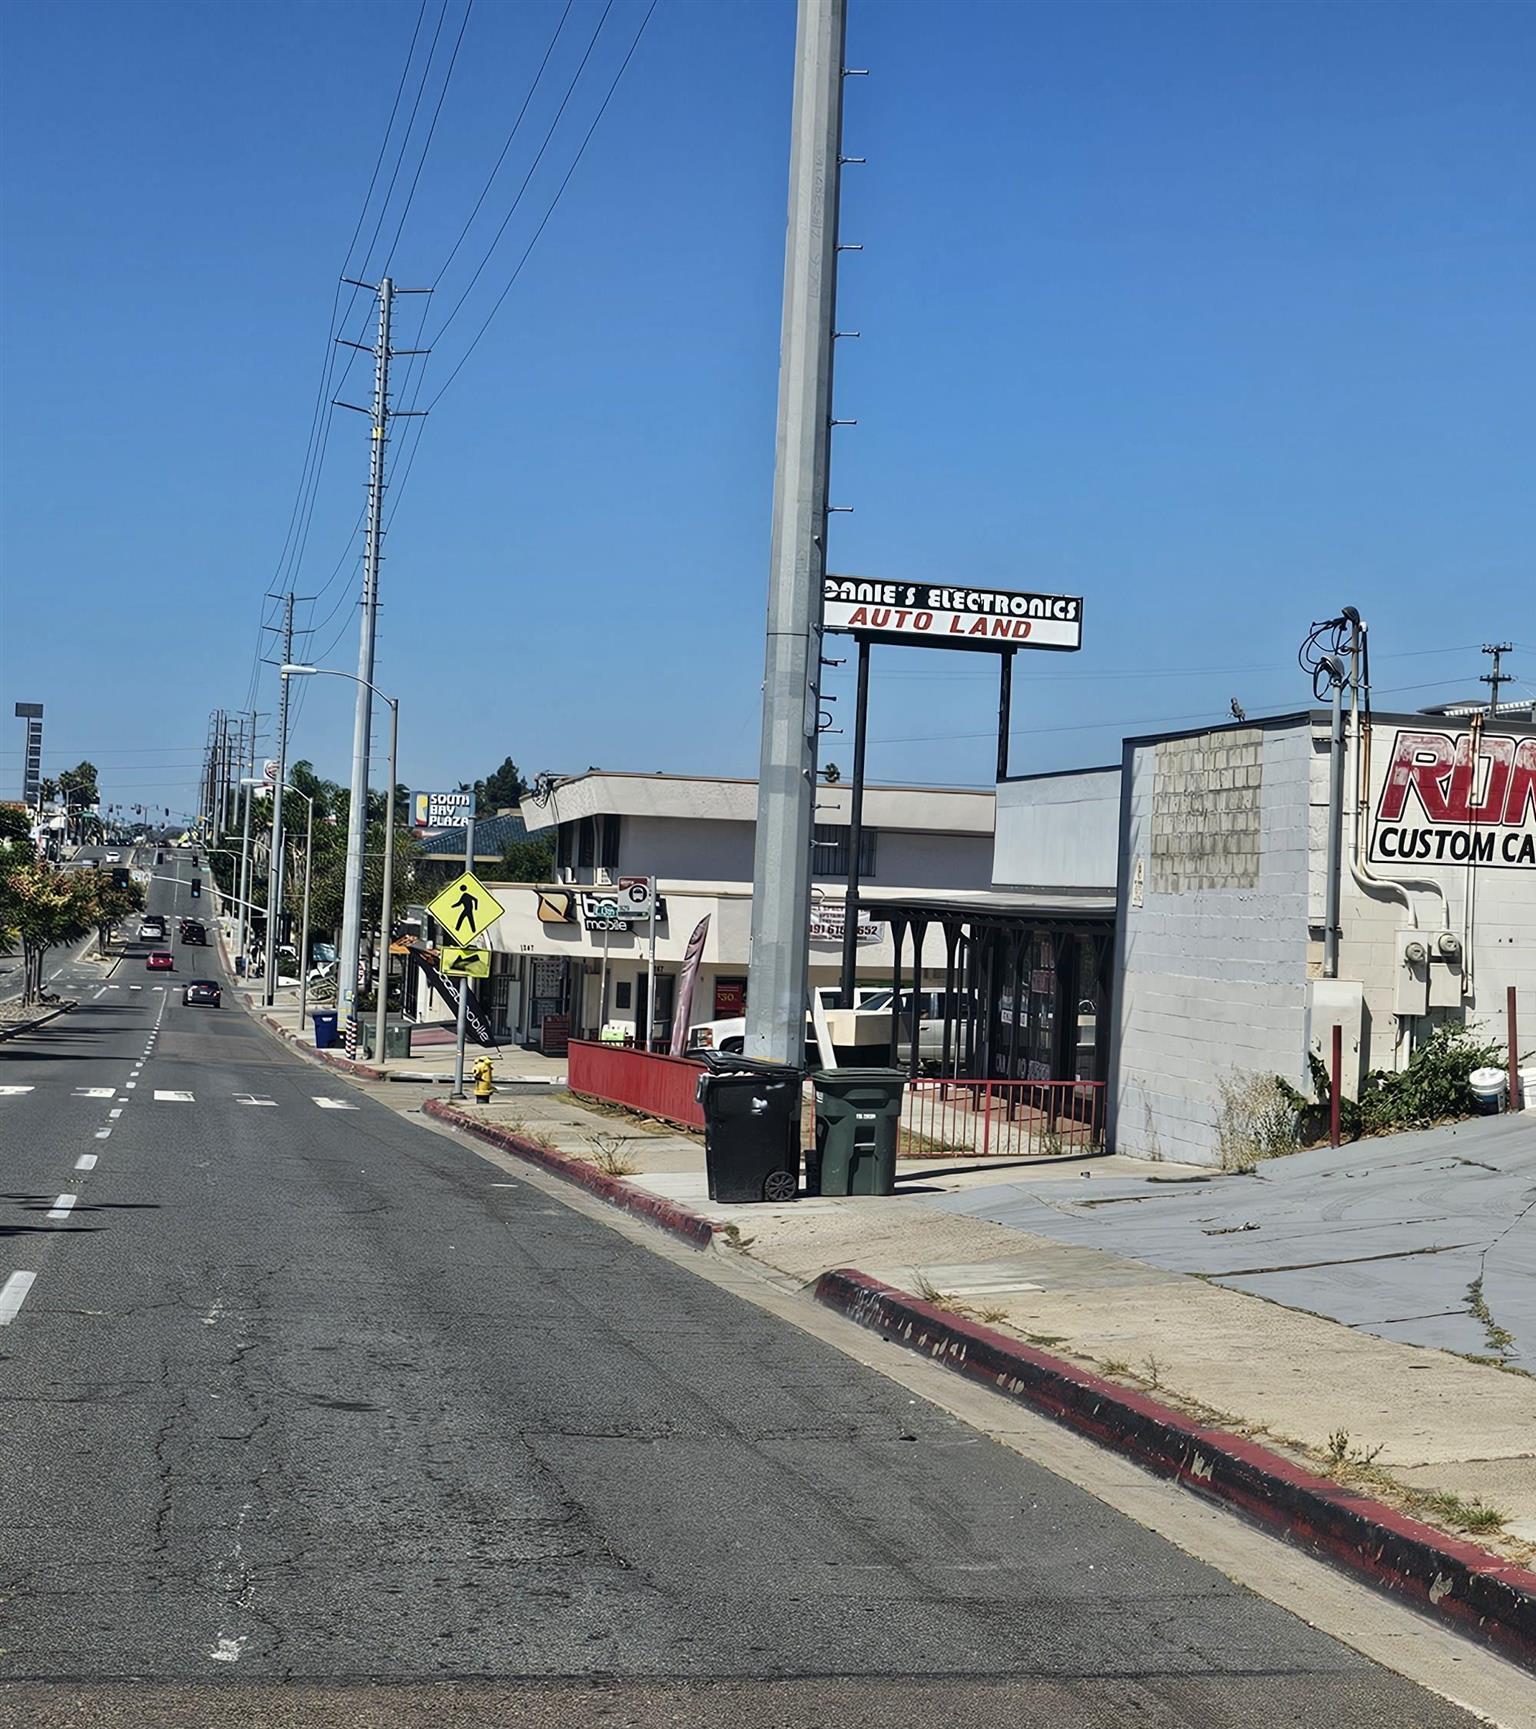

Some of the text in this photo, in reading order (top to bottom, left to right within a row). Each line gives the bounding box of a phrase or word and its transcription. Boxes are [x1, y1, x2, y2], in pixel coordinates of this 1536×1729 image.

[825, 580, 1077, 620] ONNIE'S ELECTRONICS
[848, 607, 1032, 639] AUTO LAND
[430, 794, 470, 806] SOUTH
[430, 805, 456, 816] BAY
[429, 816, 469, 827] PLAZA
[1379, 827, 1495, 862] CUSTOM
[466, 1005, 489, 1042] obile
